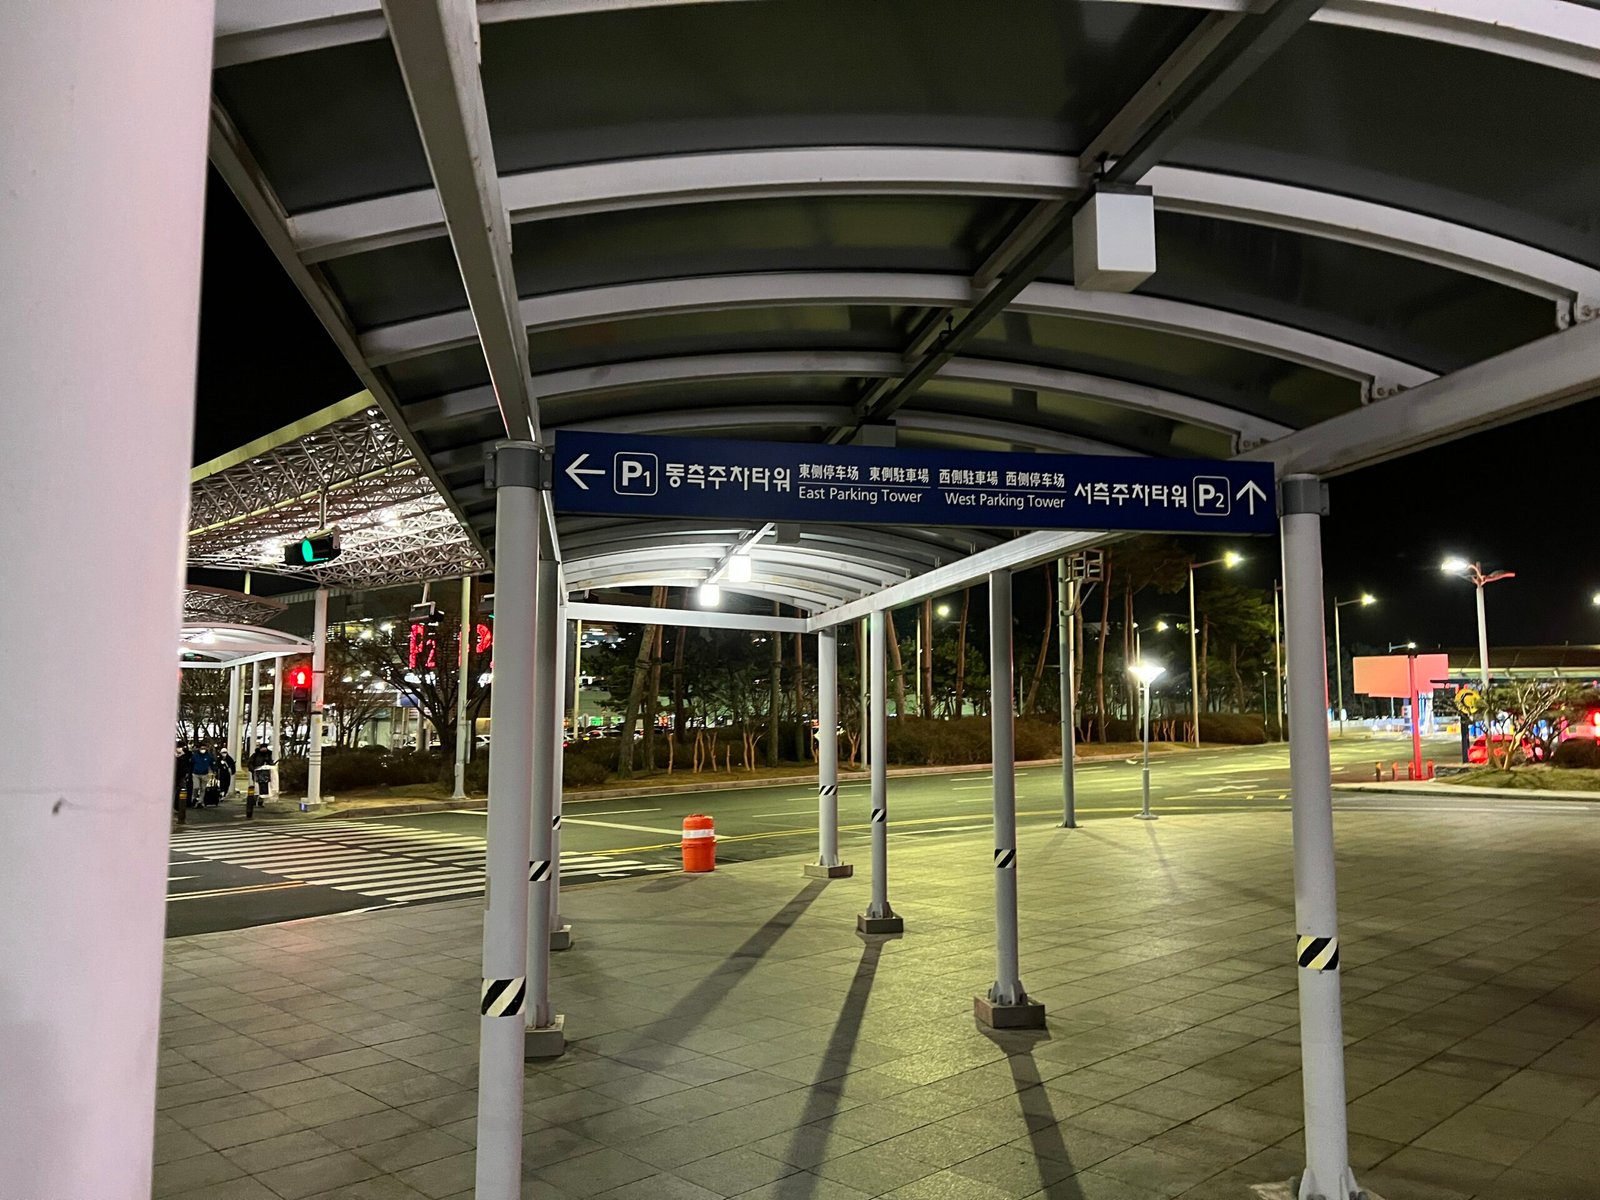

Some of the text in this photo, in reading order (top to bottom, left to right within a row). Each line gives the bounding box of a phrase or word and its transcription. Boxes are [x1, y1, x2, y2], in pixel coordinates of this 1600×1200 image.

[665, 463, 791, 493] 동측주차타워
[869, 466, 930, 484] 東側駐車場
[938, 468, 1066, 488] 西側駐車場 西侧停车场
[798, 486, 922, 504] East Parking Tower
[944, 492, 1066, 510] West Parking Tower
[1074, 482, 1188, 508] 서측주차타워
[1198, 484, 1225, 508] P2
